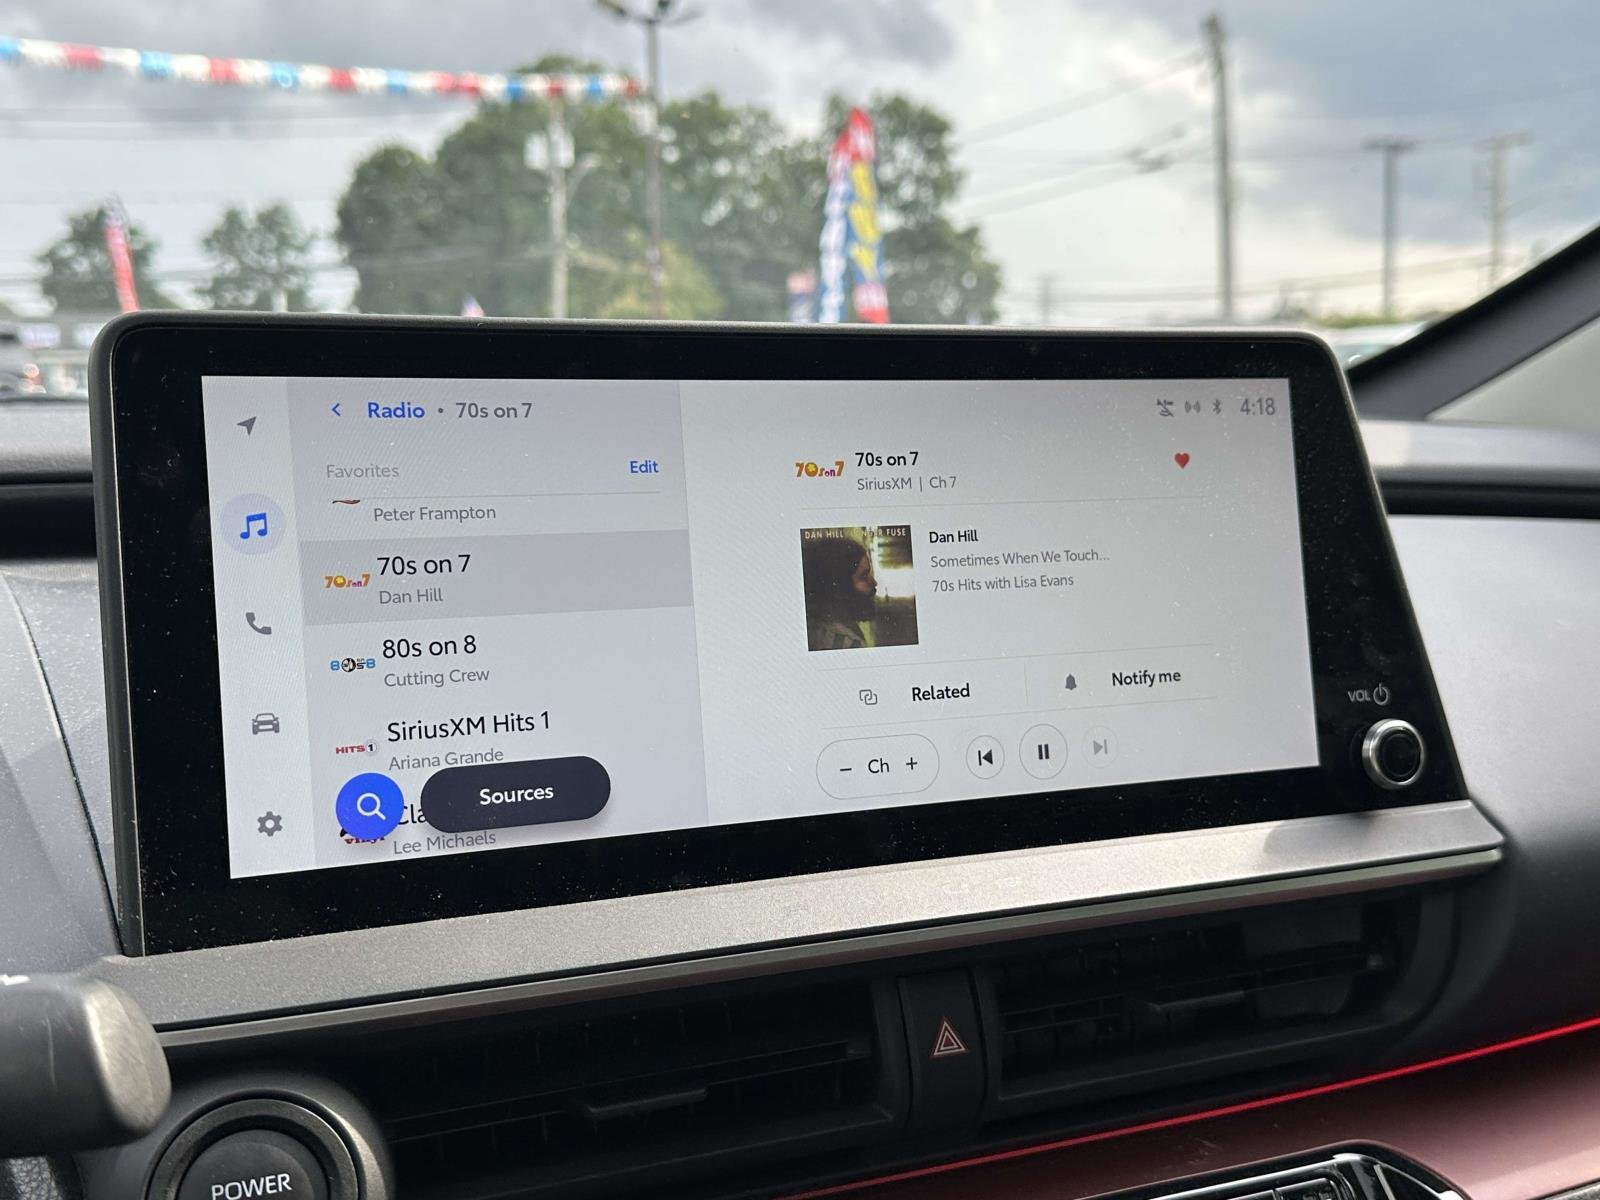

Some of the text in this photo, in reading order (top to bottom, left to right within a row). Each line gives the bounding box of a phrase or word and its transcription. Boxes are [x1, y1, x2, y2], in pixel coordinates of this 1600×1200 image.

[367, 402, 532, 419] Radio 70s on 7
[1240, 398, 1276, 416] 4:18
[630, 460, 658, 474] Edit
[855, 452, 919, 467] 70s on 7
[326, 464, 399, 478] Favorites
[857, 476, 957, 491] SiriusXM Ch 7
[374, 506, 496, 523] Peter Frampton
[805, 531, 822, 539] DAN
[826, 530, 844, 539] HILL
[886, 528, 906, 537] FUSE
[929, 529, 978, 544] Dan Hill
[377, 555, 471, 576] 70s on 7
[930, 550, 1110, 568] Sometimes When We Touch...
[932, 574, 1074, 593] 70s Hits with Lisa Evans
[379, 588, 443, 604] Dan Hill
[383, 635, 477, 659] 80s on 8
[384, 668, 489, 687] Cutting Crew
[1112, 669, 1181, 688] Notify me
[912, 683, 970, 702] Related
[1347, 690, 1371, 702] VOL
[388, 711, 550, 742] SiriusXM Hits 1
[335, 743, 374, 754] HITS 1
[389, 749, 503, 771] Ariana Grande
[868, 758, 890, 774] Ch
[479, 784, 554, 805] Sources
[393, 839, 423, 856] Lee
[427, 831, 496, 851] Michaels
[211, 1173, 292, 1200] POWER
